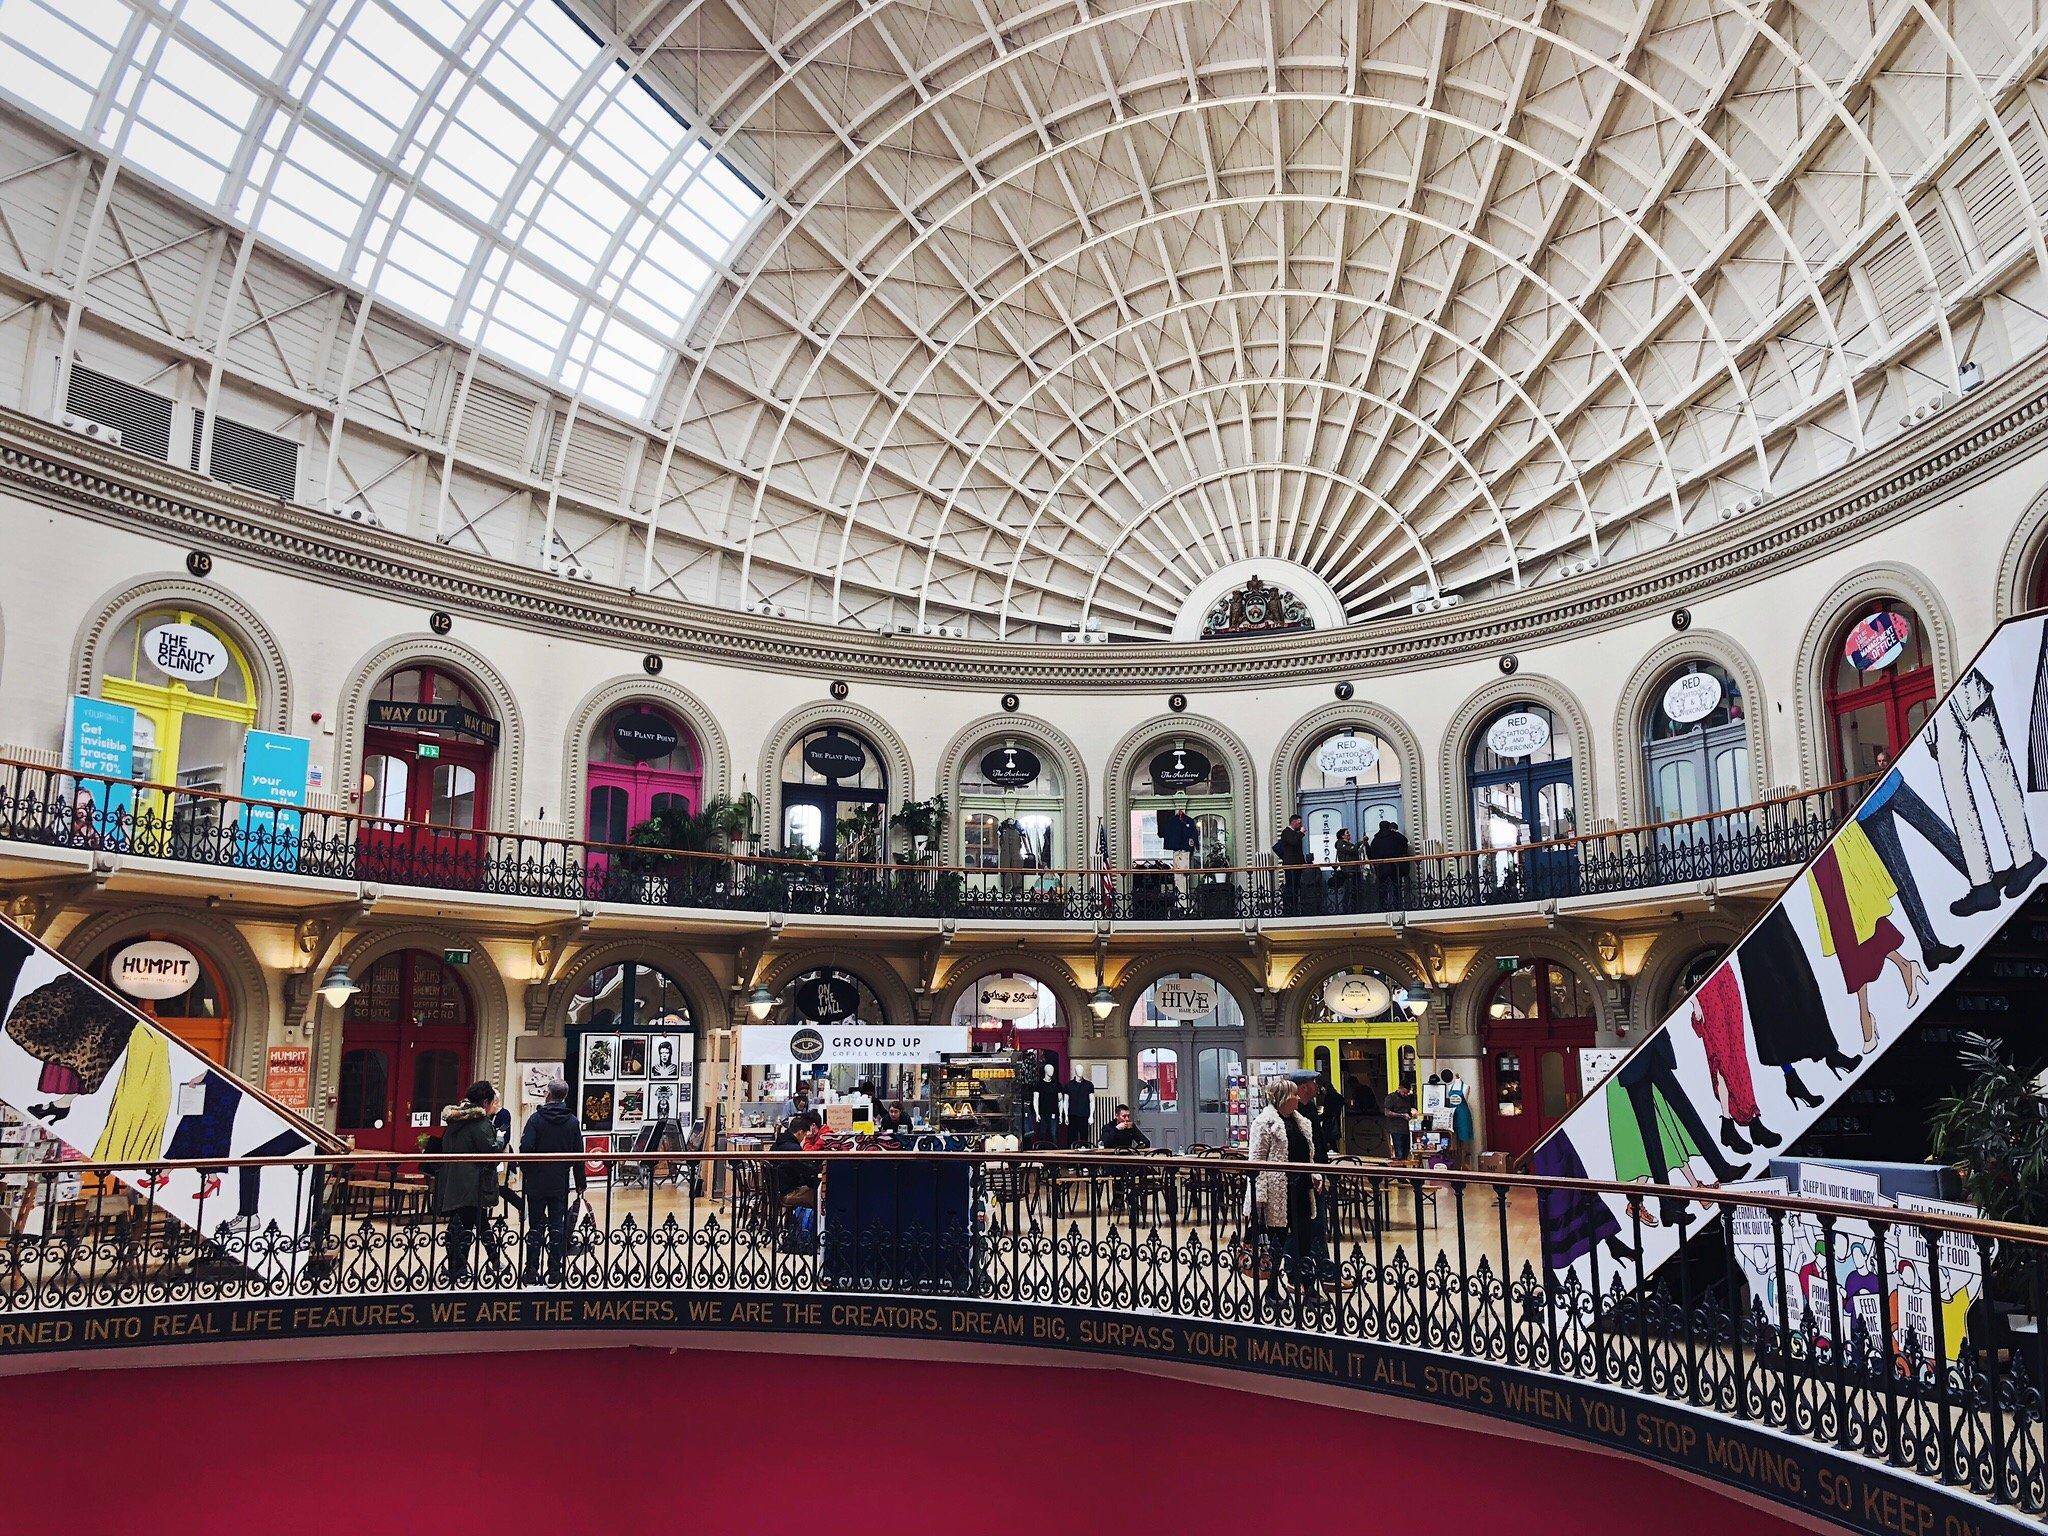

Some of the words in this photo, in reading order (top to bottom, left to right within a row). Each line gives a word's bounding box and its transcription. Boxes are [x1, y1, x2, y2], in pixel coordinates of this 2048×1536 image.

[193, 554, 209, 570] 13
[435, 615, 449, 629] 12
[1676, 613, 1684, 625] 5
[159, 631, 188, 648] THE
[1860, 626, 1894, 657] MANAGEMENT
[1871, 633, 1897, 659] OFFICE
[158, 642, 215, 665] BEAUTY
[158, 655, 205, 674] CLINIC
[649, 657, 658, 669] 11
[1503, 658, 1511, 669] 6
[834, 683, 847, 695] 10
[1682, 676, 1700, 690] RED
[1340, 685, 1348, 696] 7
[1007, 697, 1015, 707] 9
[1173, 697, 1182, 706] 8
[380, 706, 413, 722] WAY
[417, 708, 448, 723] OUT
[464, 714, 480, 732] WAY
[481, 721, 495, 738] OUT
[1507, 716, 1527, 727] RED
[81, 722, 102, 735] Get
[618, 728, 632, 737] THE
[634, 730, 655, 740] PLANT
[656, 733, 676, 742] POINT
[1506, 728, 1530, 736] TATTOO
[81, 733, 127, 752] invisible
[1337, 740, 1357, 749] RED
[1504, 744, 1534, 752] PIERCING
[80, 745, 119, 762] braces
[824, 752, 842, 760] PLANT
[1335, 751, 1359, 759] TATTOO
[80, 757, 97, 769] for
[1333, 765, 1363, 773] PIERCING
[992, 769, 1003, 777] The
[1003, 769, 1030, 777] Archives
[1160, 770, 1171, 779] The
[1171, 770, 1199, 779] Archives
[252, 775, 282, 786] your
[270, 787, 298, 798] new
[122, 956, 191, 976] HUMPIT
[818, 982, 831, 995] ON
[1165, 983, 1181, 991] THE
[818, 993, 837, 1007] THE
[1161, 989, 1209, 1008] HIVE
[354, 1008, 391, 1017] SOUTH
[817, 1001, 843, 1016] WALL
[802, 1042, 814, 1050] UP
[832, 1037, 896, 1047] GROUND
[902, 1037, 921, 1047] UP
[270, 1051, 307, 1061] HUMPIT
[415, 1113, 429, 1121] Lift
[1802, 1179, 1819, 1194] SLEEP
[1828, 1183, 1849, 1201] YOU'RE
[1742, 1221, 1751, 1234] ME
[1751, 1221, 1763, 1234] OUT
[1764, 1221, 1772, 1234] OF
[1915, 1240, 1928, 1258] OU
[1947, 1246, 1970, 1266] FOOD
[1860, 1298, 1878, 1314] FEED
[1907, 1294, 1923, 1314] HOT
[1866, 1315, 1879, 1332] ME
[1906, 1312, 1927, 1332] DOGS
[84, 1315, 142, 1341] INTO
[153, 1312, 220, 1337] REAL
[231, 1309, 282, 1332] LIFE
[293, 1304, 420, 1330] FEATURES.
[431, 1302, 466, 1323] WE
[475, 1301, 521, 1322] ARE
[532, 1300, 573, 1322] THE
[583, 1300, 678, 1322] MAKERS,
[688, 1301, 722, 1322] WE
[730, 1302, 774, 1323] ARE
[782, 1303, 822, 1325] THE
[831, 1306, 942, 1331] CREATORS.
[952, 1310, 1024, 1336] DREAM
[1033, 1316, 1069, 1342] BIG,
[1079, 1320, 1174, 1352] SURPASS
[1183, 1331, 1237, 1359] YOUR
[1347, 1352, 1365, 1378] IT
[1374, 1357, 1416, 1389] ALL
[1423, 1366, 1493, 1404] STOPS
[1500, 1379, 1572, 1423] WHEN
[1580, 1396, 1627, 1437] YOU
[1635, 1412, 1697, 1455] STOP
[1817, 1468, 1852, 1512] SO
[1862, 1483, 1935, 1536] KEEP
